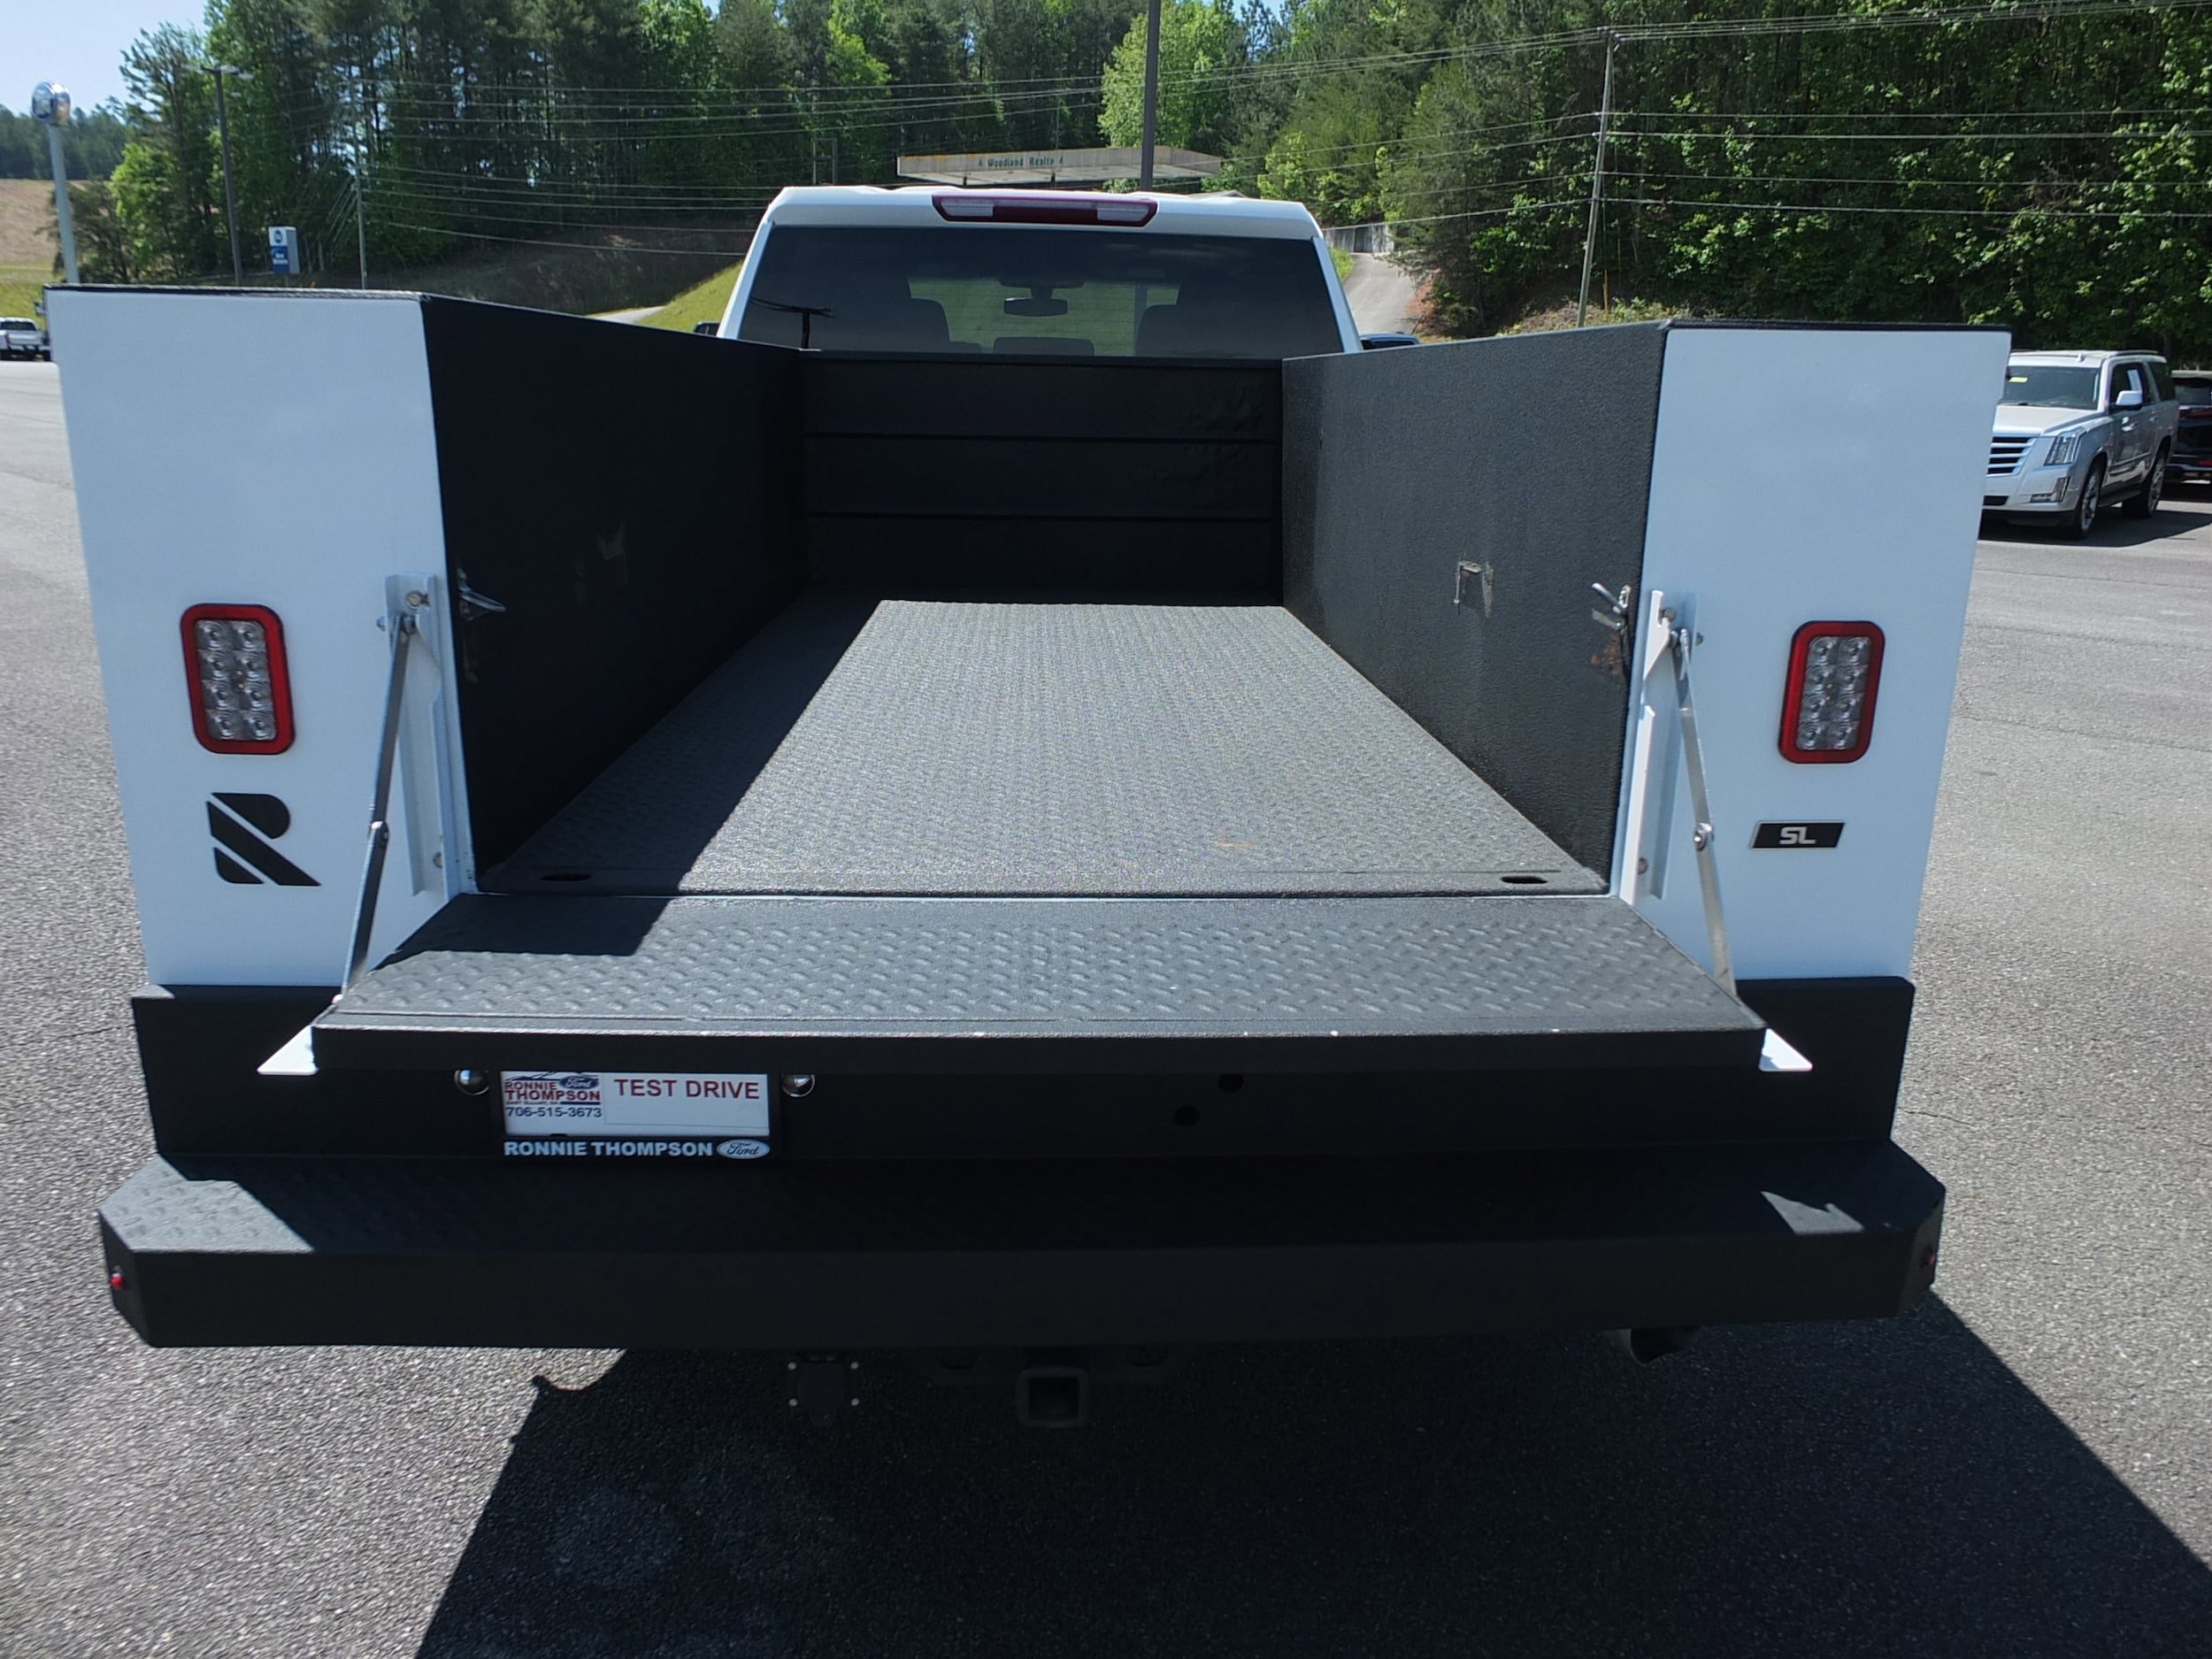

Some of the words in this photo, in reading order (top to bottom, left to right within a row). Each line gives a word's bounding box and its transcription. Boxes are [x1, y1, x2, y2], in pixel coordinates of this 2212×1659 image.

[987, 157, 1024, 167] Woodland
[1029, 156, 1055, 165] Realty
[1778, 826, 1816, 845] SL
[504, 1081, 557, 1090] RONNIE
[613, 1079, 678, 1097] TEST
[685, 1080, 760, 1100] DRIVE
[504, 1090, 601, 1101] THOMPSON
[505, 1106, 603, 1118] 706-515-3673
[503, 1141, 588, 1156] RONNIE
[590, 1141, 713, 1156] THOMPSON
